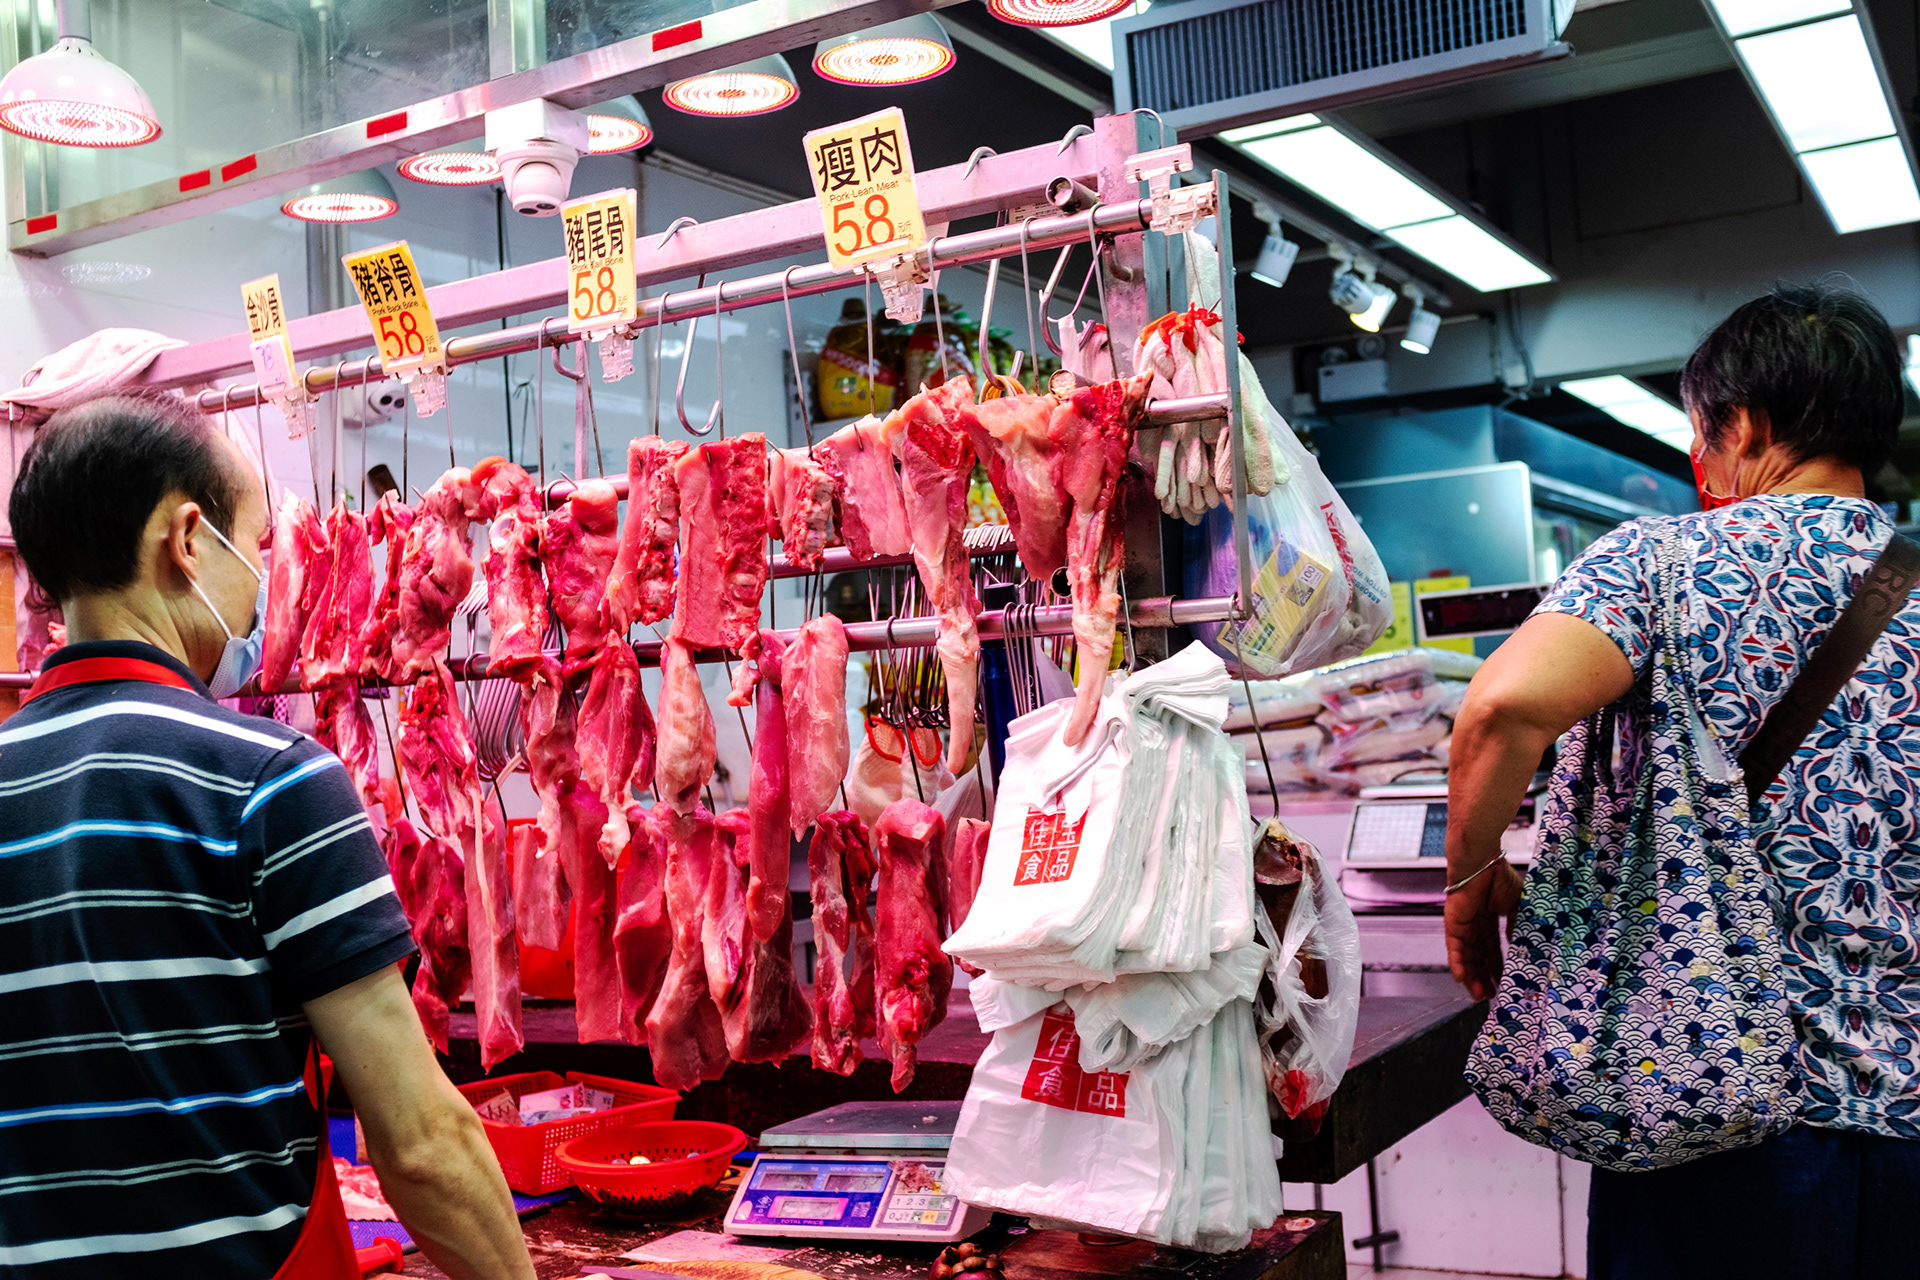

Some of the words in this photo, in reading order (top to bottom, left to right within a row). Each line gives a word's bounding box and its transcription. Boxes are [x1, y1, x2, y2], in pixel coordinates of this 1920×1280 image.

[814, 127, 903, 192] 瘦肉
[829, 187, 875, 203] Pork-Lean
[876, 180, 900, 192] Meat
[566, 206, 624, 264] 豬尾骨
[833, 194, 895, 256] 58
[351, 253, 417, 306] 豬脊骨
[572, 264, 589, 273] Pork
[605, 257, 624, 267] Bone
[247, 287, 281, 333] 金沙骨
[372, 307, 386, 317] Pork
[387, 304, 402, 313] Back
[403, 301, 419, 310] Bone
[574, 266, 616, 320] 58
[378, 311, 425, 359] 58
[1301, 565, 1316, 582] 100
[1364, 576, 1387, 598] COTTON
[1020, 850, 1069, 882] 食品
[1034, 1065, 1118, 1111] 食品
